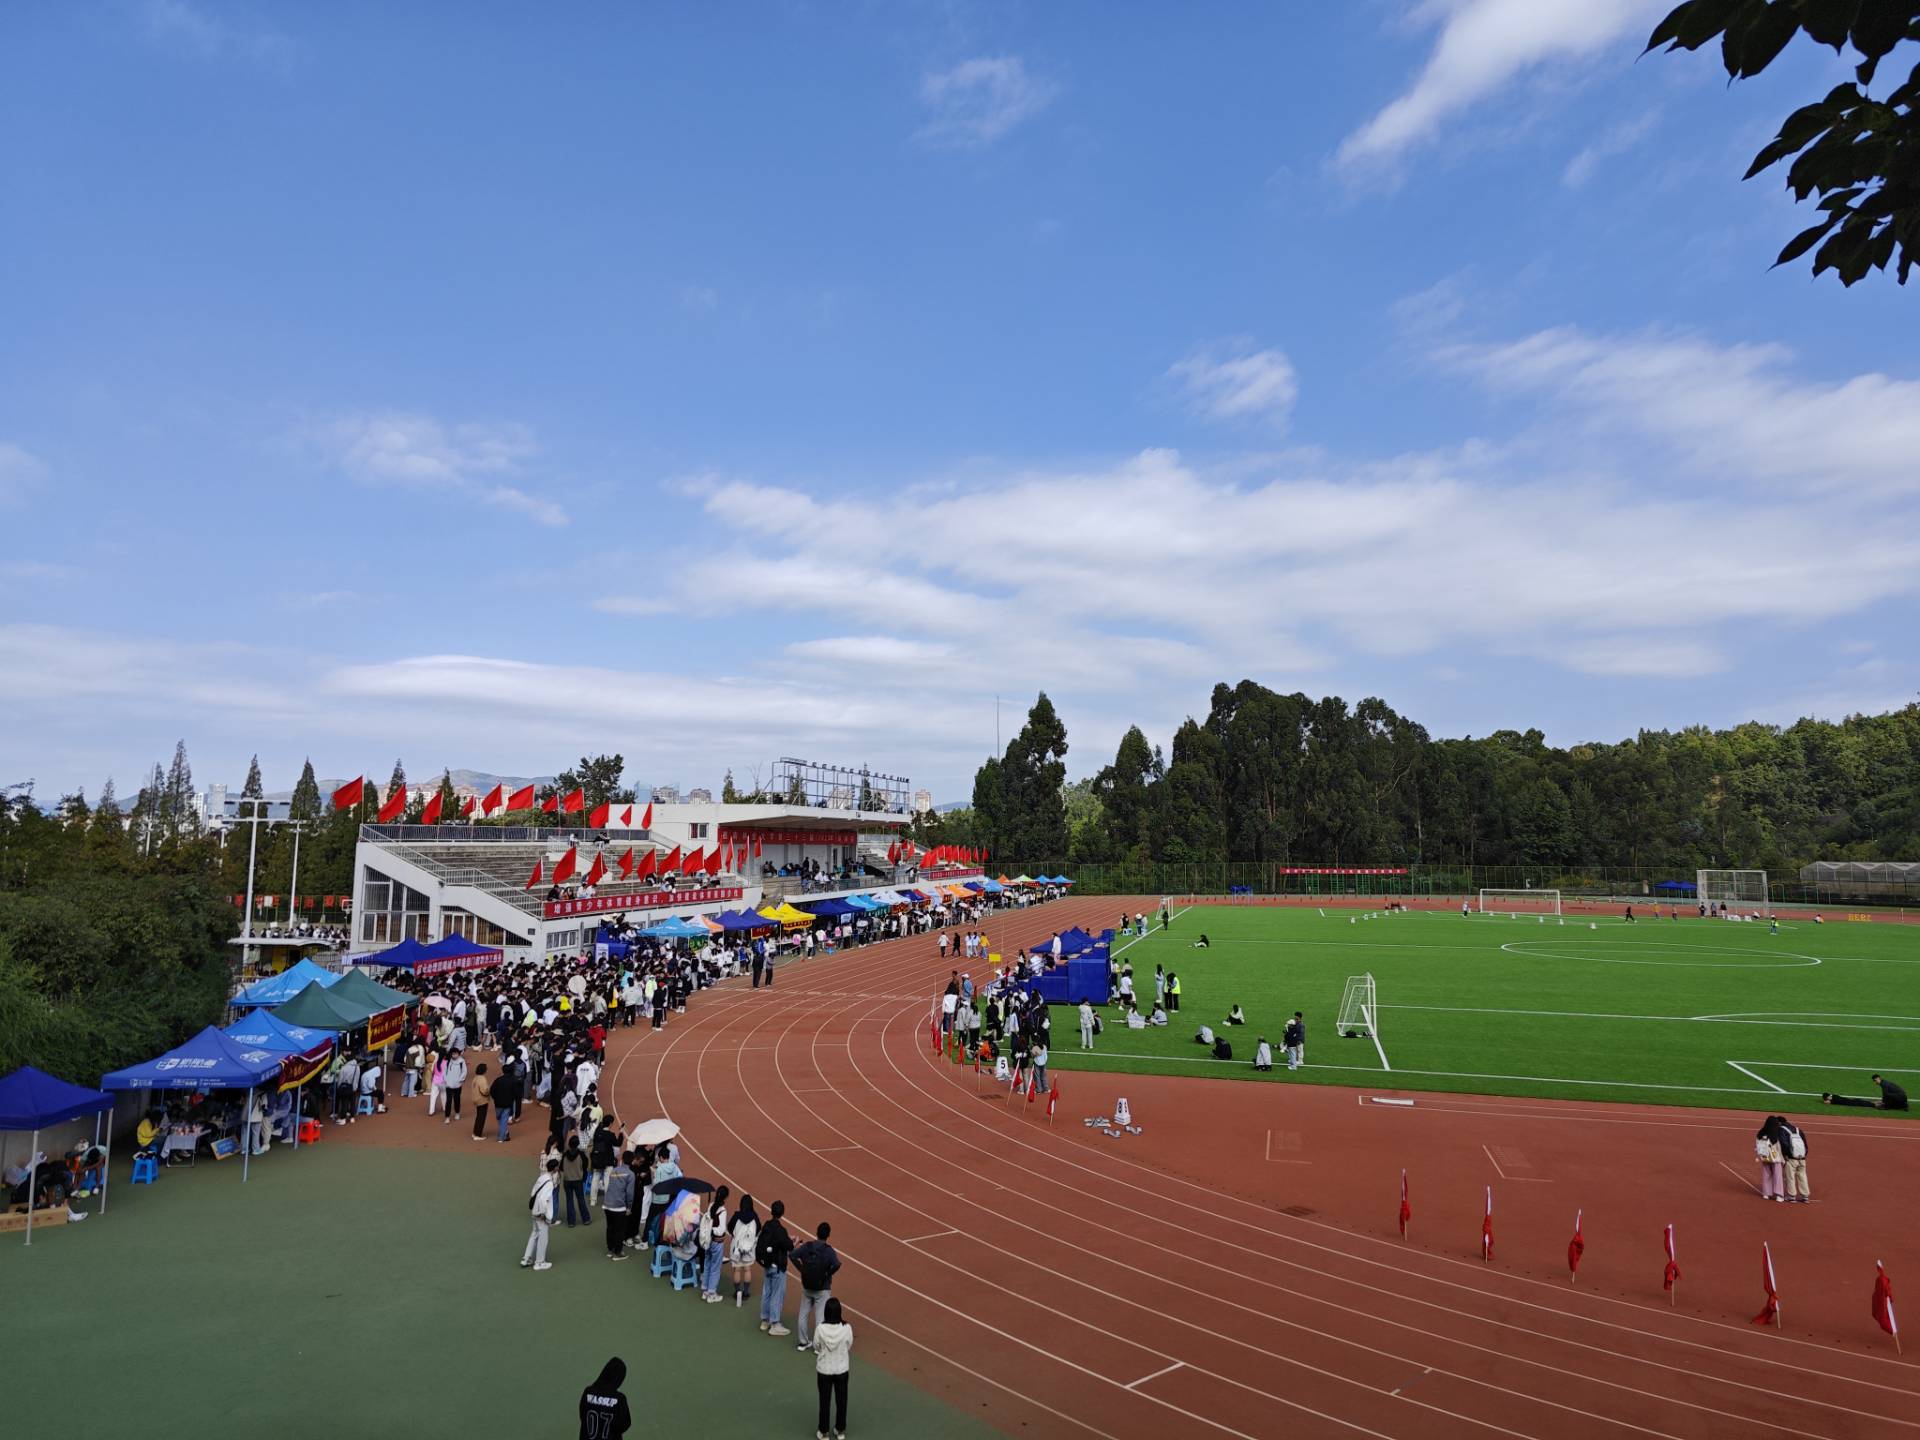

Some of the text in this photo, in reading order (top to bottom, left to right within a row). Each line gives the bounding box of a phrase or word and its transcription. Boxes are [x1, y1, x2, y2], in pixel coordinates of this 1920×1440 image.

[1000, 1059, 1006, 1070] 5
[586, 1394, 618, 1407] WASSUP
[587, 1410, 614, 1440] 07
